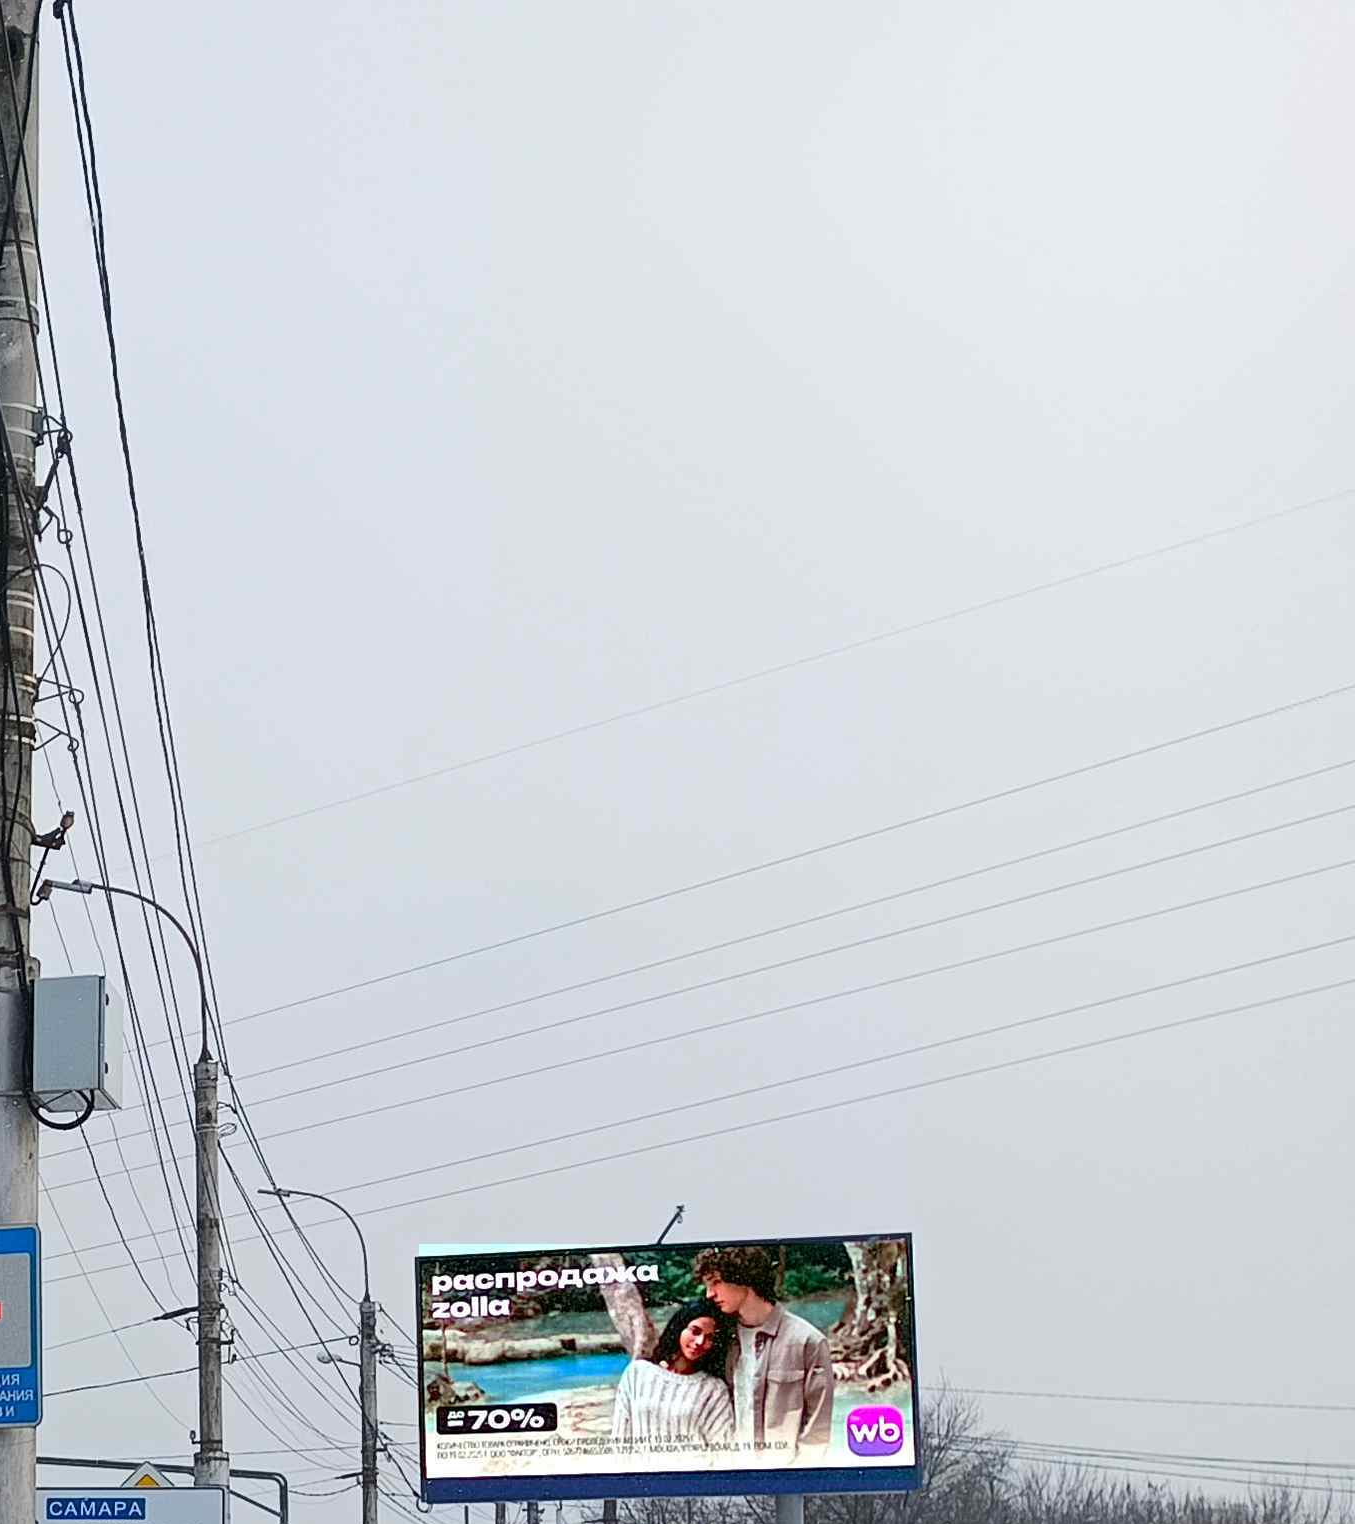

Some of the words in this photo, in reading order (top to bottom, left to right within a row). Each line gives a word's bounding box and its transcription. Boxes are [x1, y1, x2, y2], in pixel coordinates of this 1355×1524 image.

[431, 1265, 659, 1295] распродажа
[431, 1296, 510, 1319] zolla
[849, 1415, 901, 1443] wb
[49, 1501, 142, 1516] САМАРА
